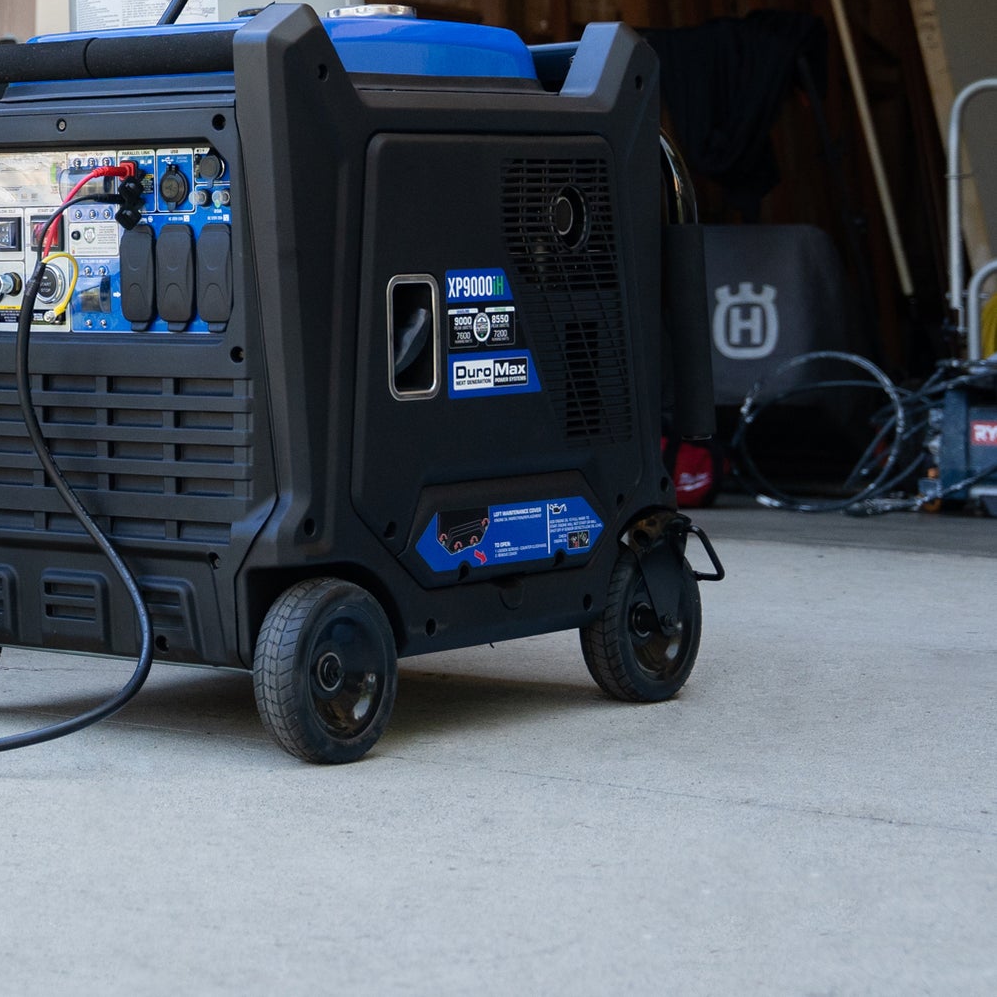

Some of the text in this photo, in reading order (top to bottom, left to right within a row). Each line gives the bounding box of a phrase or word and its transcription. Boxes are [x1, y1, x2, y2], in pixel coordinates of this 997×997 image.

[447, 275, 504, 298] XP9000iH
[454, 316, 472, 326] 9000
[491, 314, 509, 324] 8550
[494, 329, 507, 338] 7200
[467, 378, 492, 386] GENERATION
